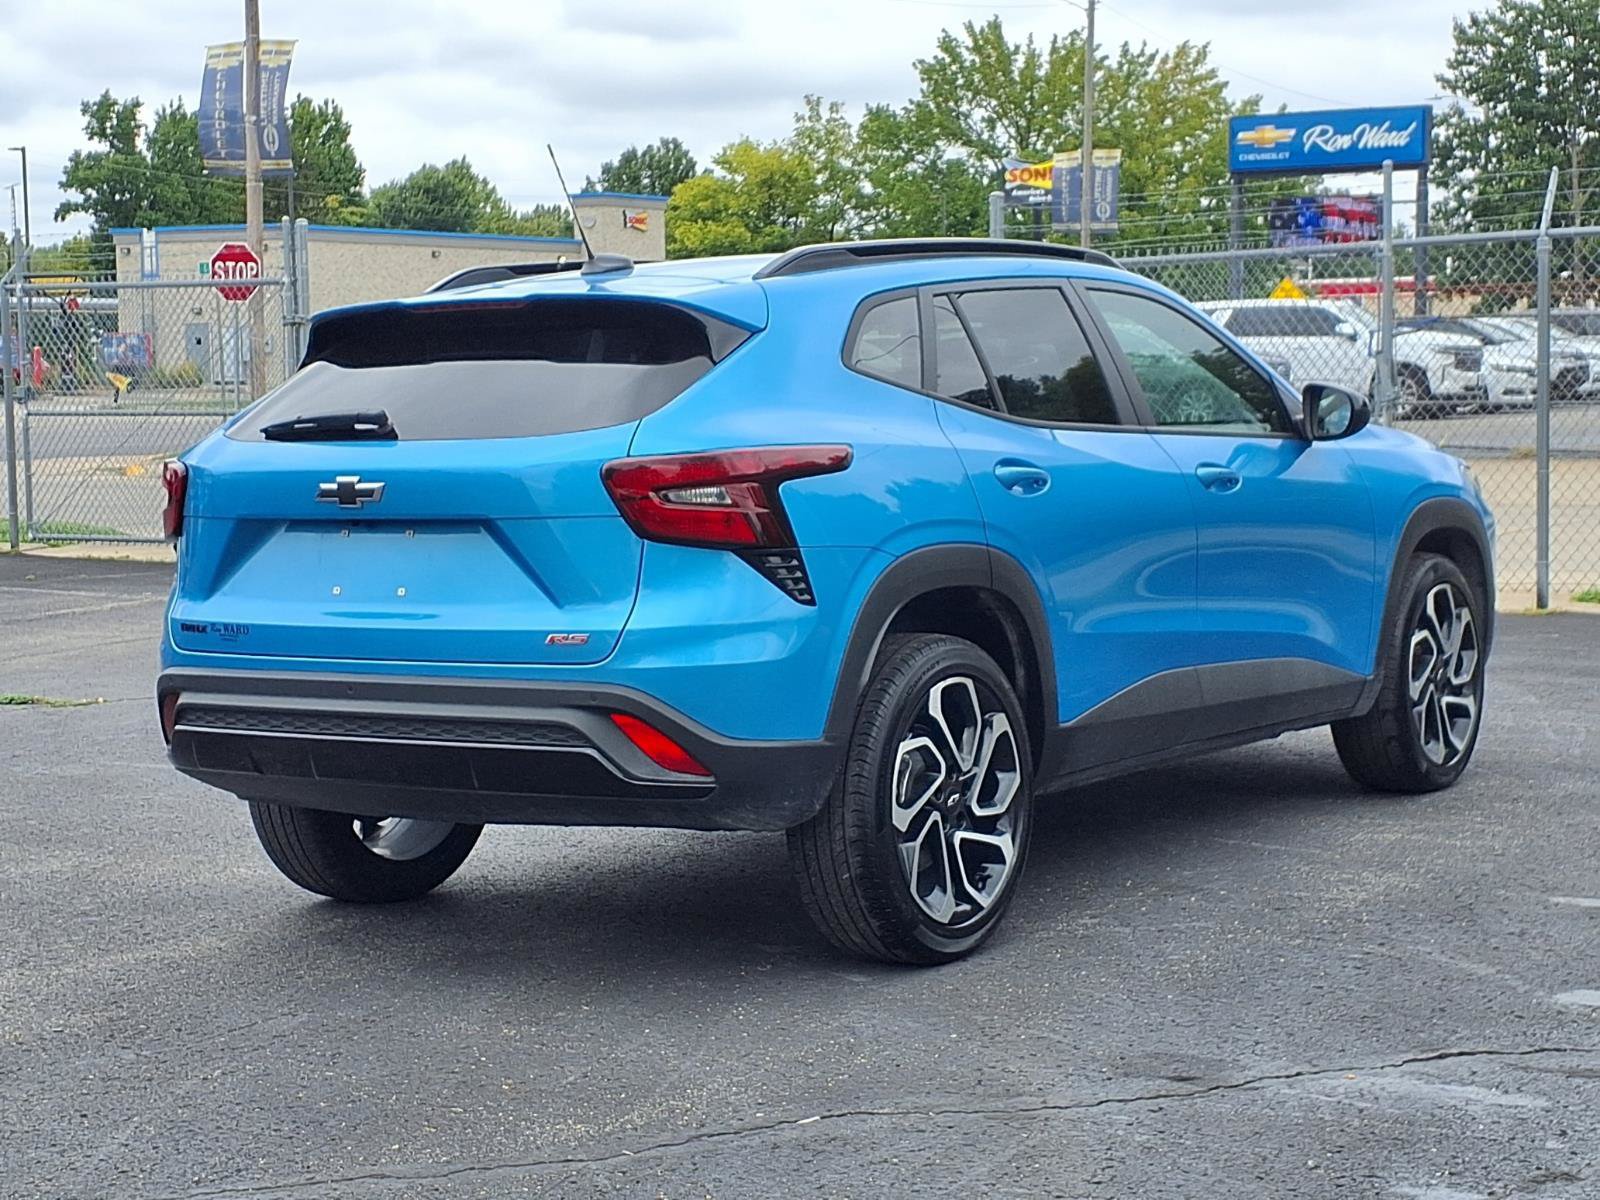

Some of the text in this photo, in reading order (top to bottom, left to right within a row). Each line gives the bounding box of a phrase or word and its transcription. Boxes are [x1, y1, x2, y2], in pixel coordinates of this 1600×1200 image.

[1303, 120, 1417, 154] Ron Ward
[1238, 152, 1290, 162] CHEVROLET
[1008, 166, 1053, 182] SONI
[214, 260, 258, 280] STOP
[545, 633, 590, 645] RS
